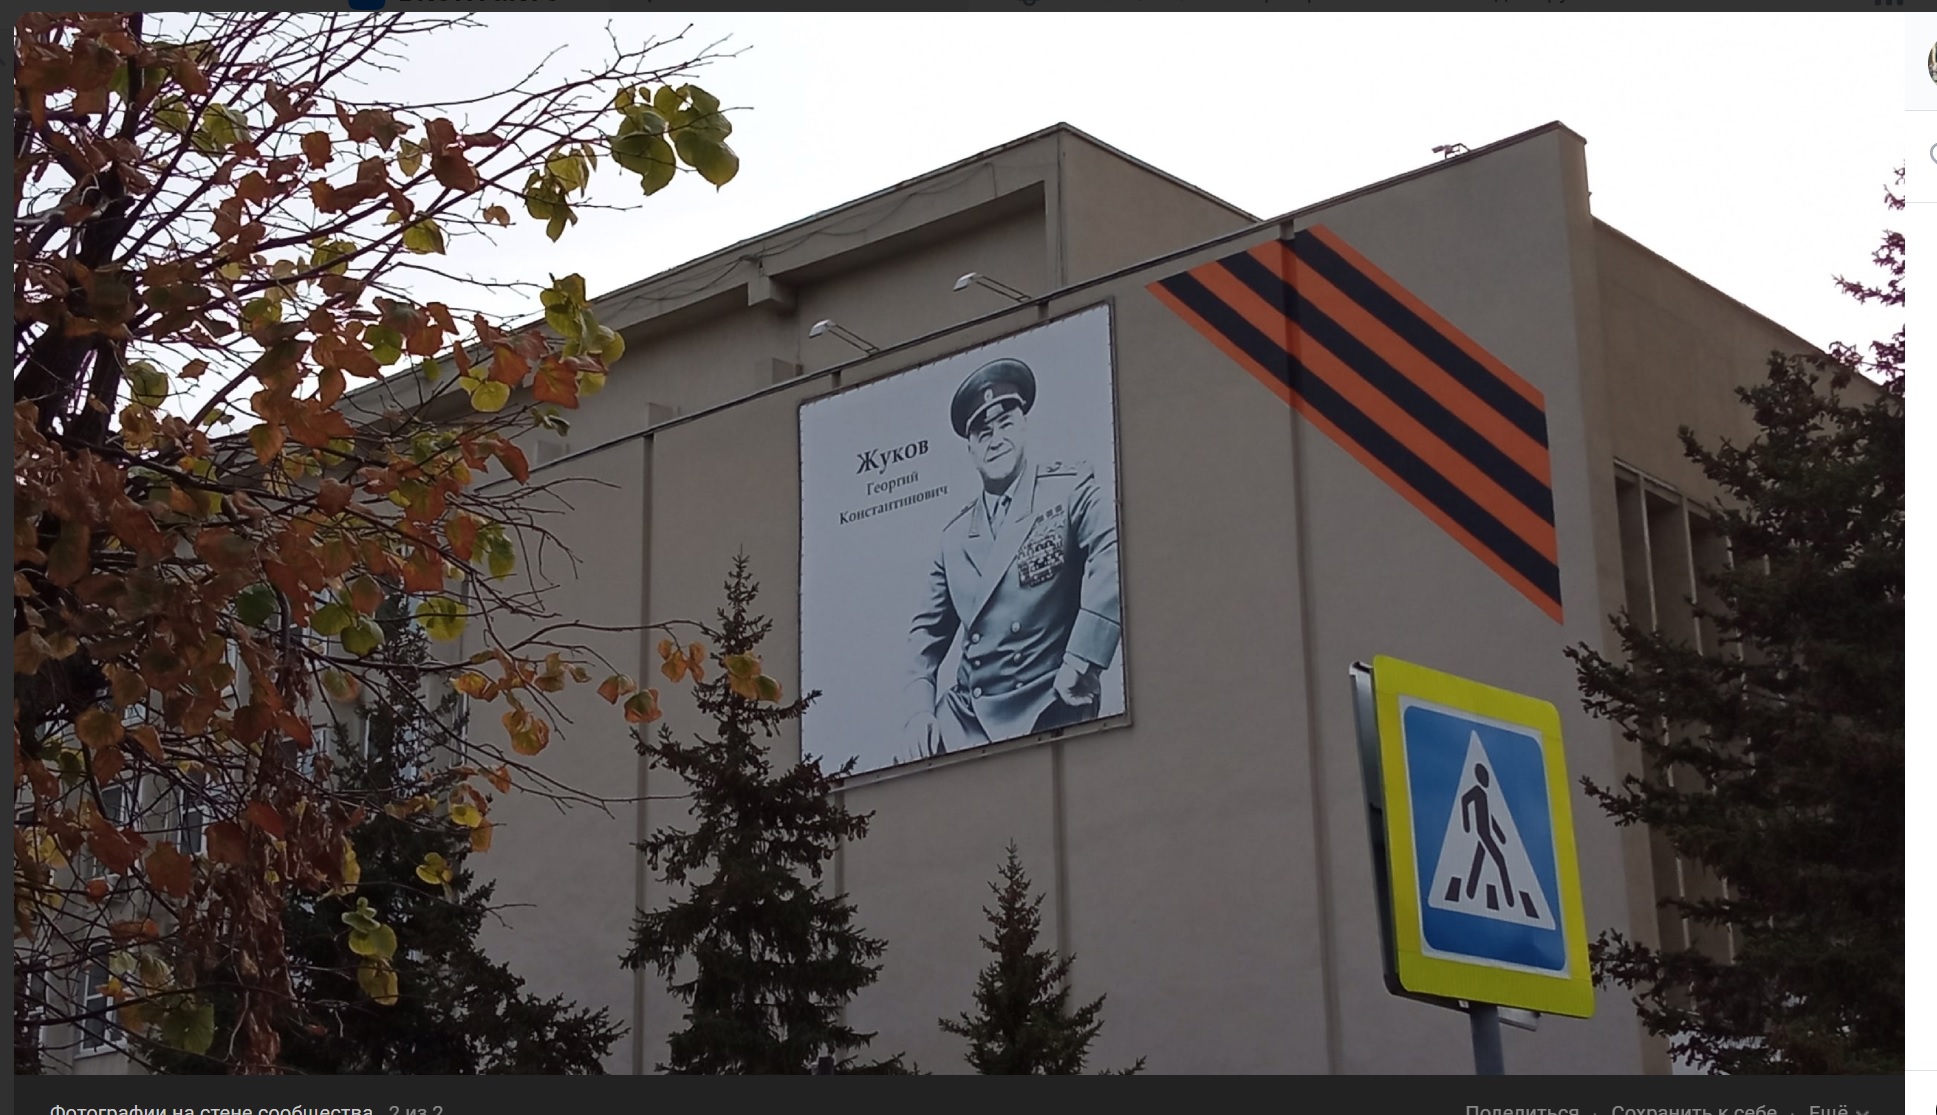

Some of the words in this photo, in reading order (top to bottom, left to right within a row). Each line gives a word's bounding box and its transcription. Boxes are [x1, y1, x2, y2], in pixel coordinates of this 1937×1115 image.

[856, 440, 929, 475] Жуков
[866, 471, 919, 496] Георгий
[839, 485, 948, 525] Константинович
